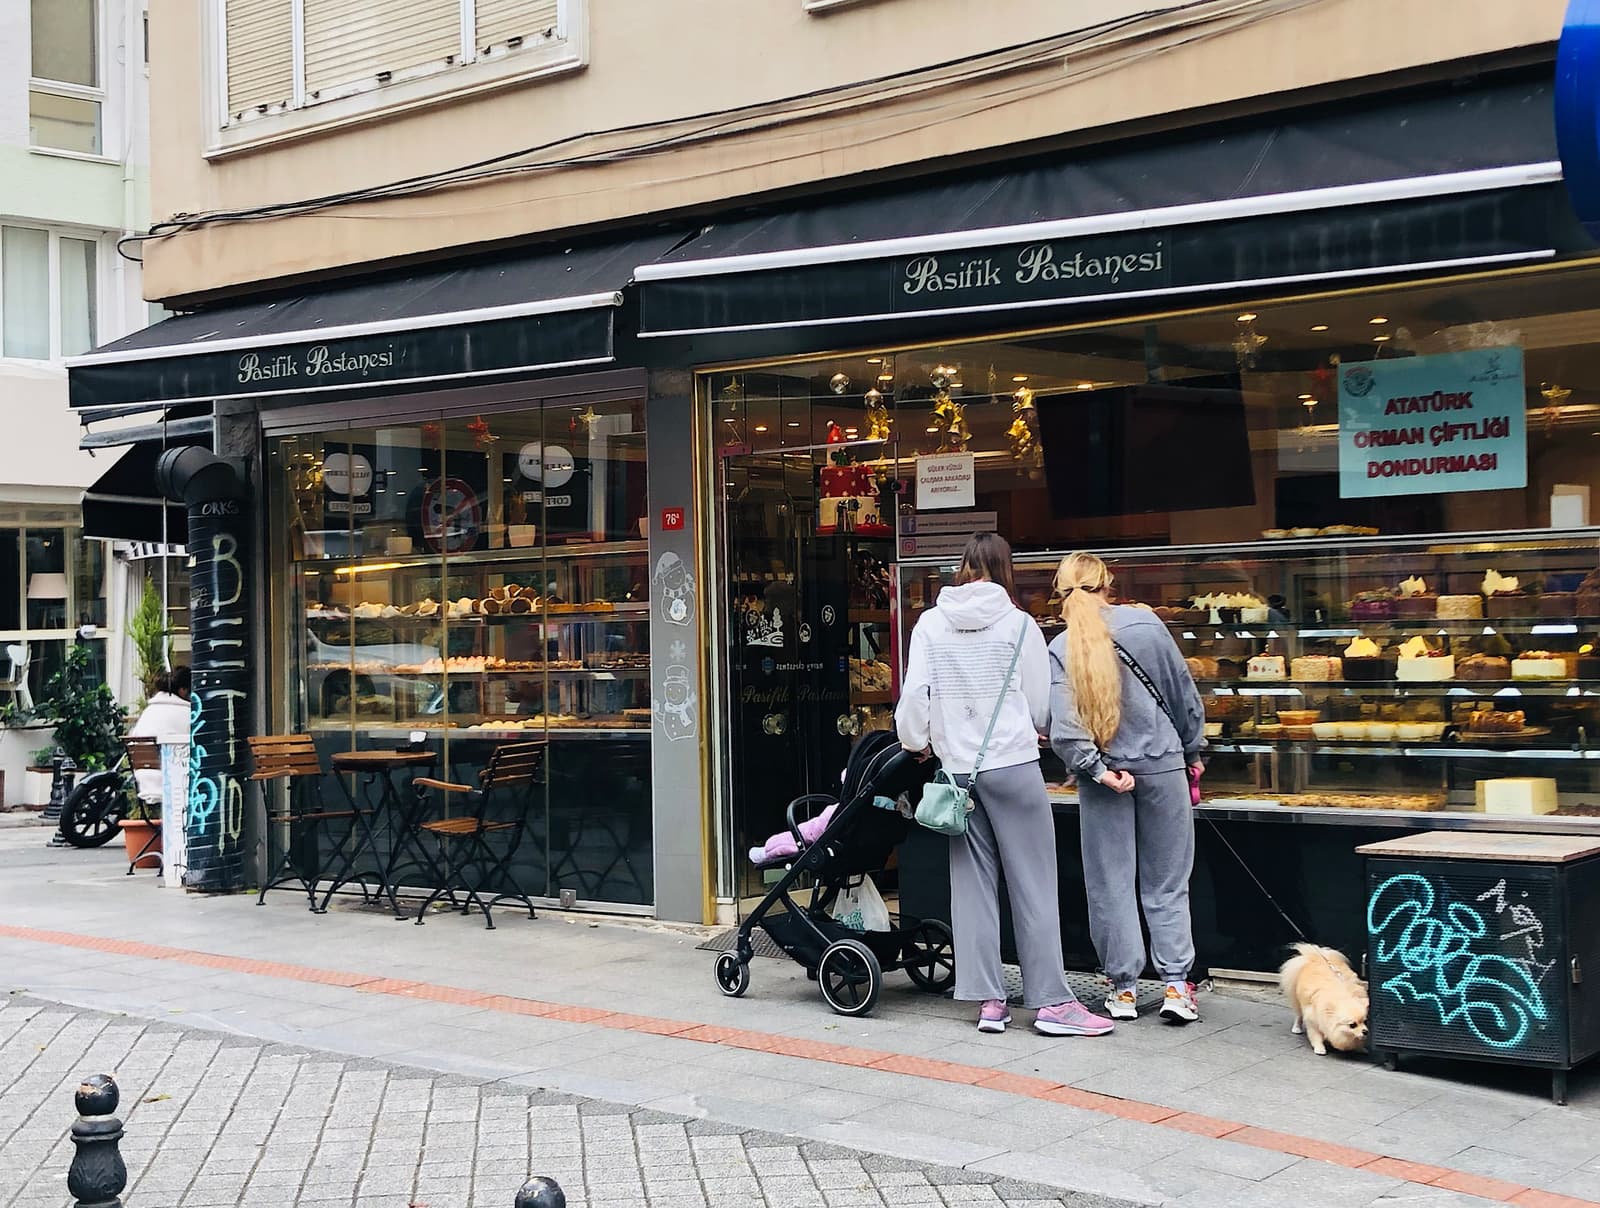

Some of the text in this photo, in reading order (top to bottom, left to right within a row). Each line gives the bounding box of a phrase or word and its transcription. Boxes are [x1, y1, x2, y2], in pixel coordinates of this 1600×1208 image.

[903, 241, 1163, 295] Pasifik Pastanesi
[238, 344, 393, 383] Pasifik Pastanesi
[1384, 390, 1473, 416] ATATÜRK
[1353, 416, 1510, 448] ORMAN ÇİFTLİĞİ
[1367, 453, 1498, 479] DONDURMASI
